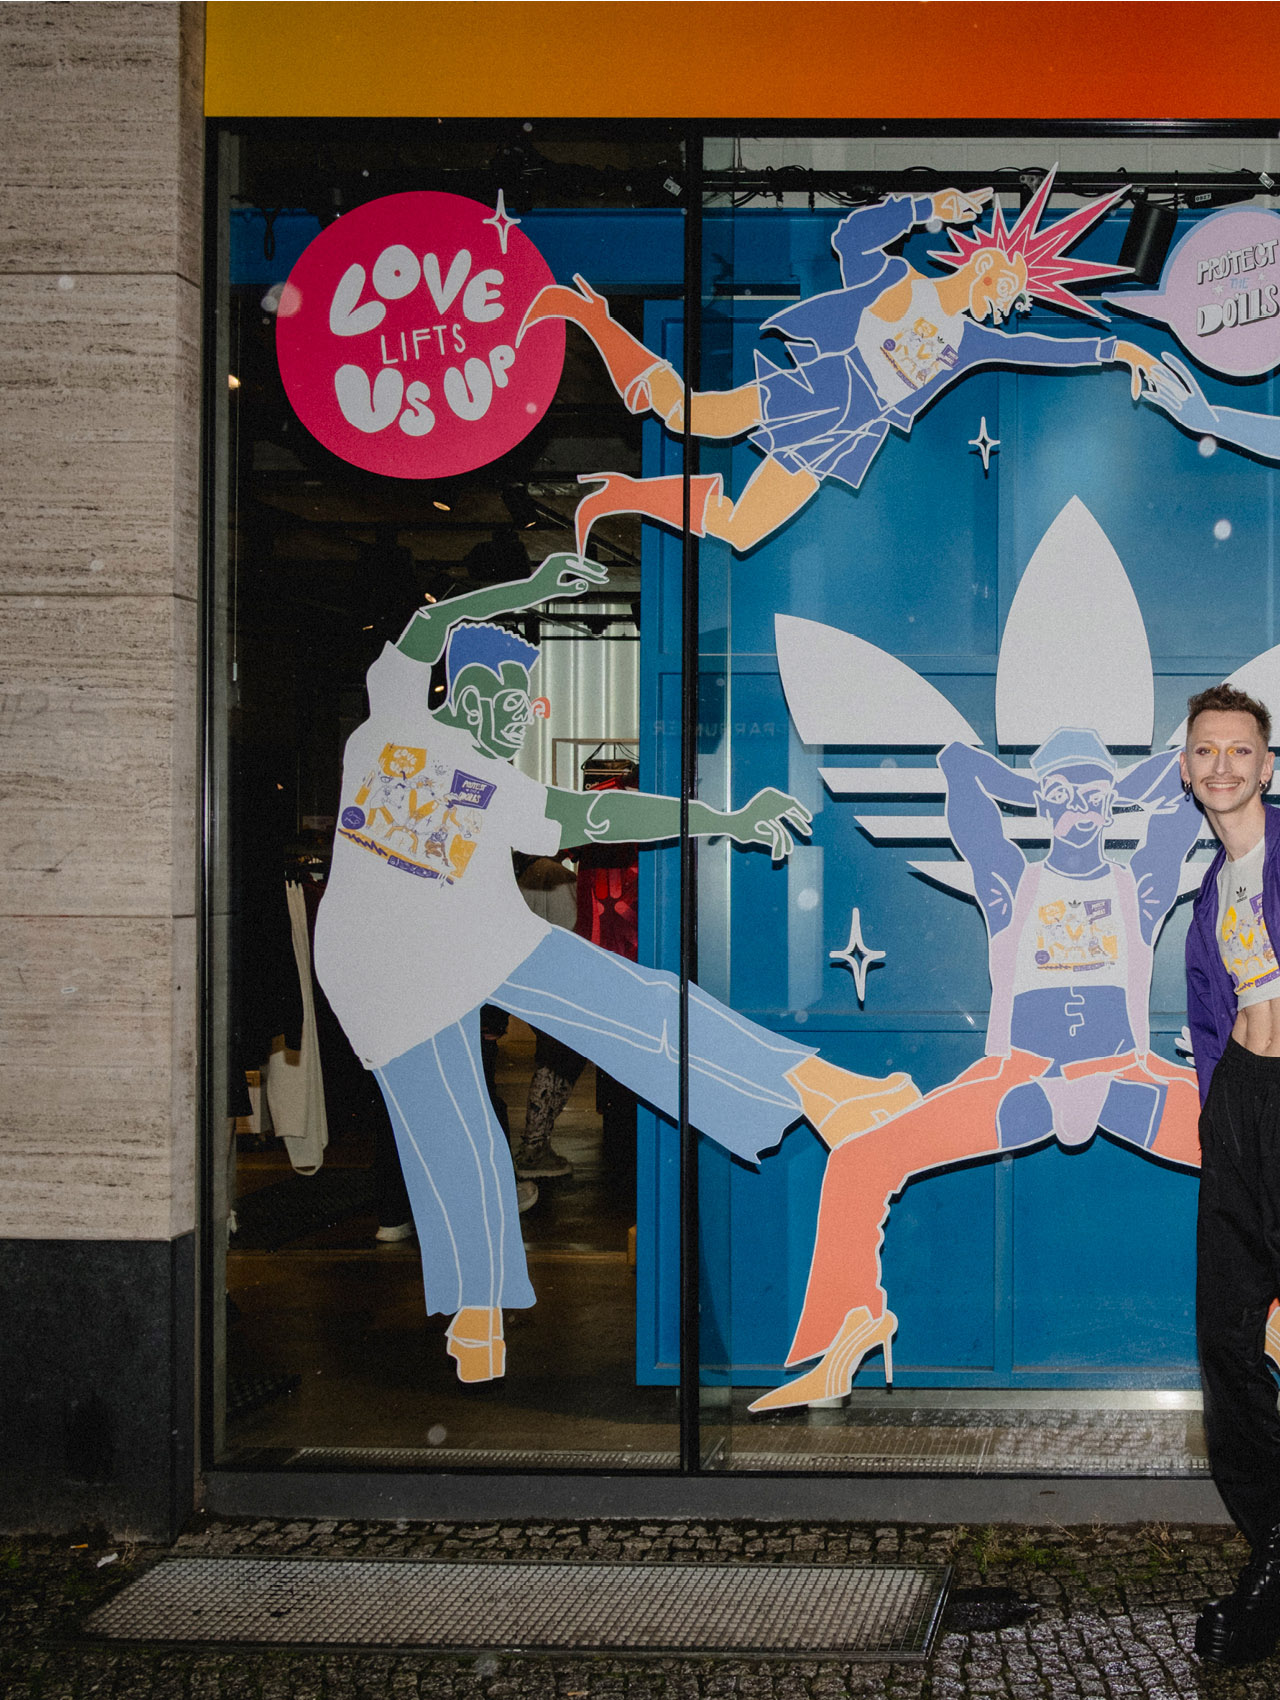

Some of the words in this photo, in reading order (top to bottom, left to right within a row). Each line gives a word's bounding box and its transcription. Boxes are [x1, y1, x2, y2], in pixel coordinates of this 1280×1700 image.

[1196, 239, 1279, 285] PROTECT
[1230, 277, 1250, 289] THE
[329, 244, 505, 337] LOVE
[1196, 284, 1280, 337] DOLLS
[380, 324, 466, 364] LIFTS
